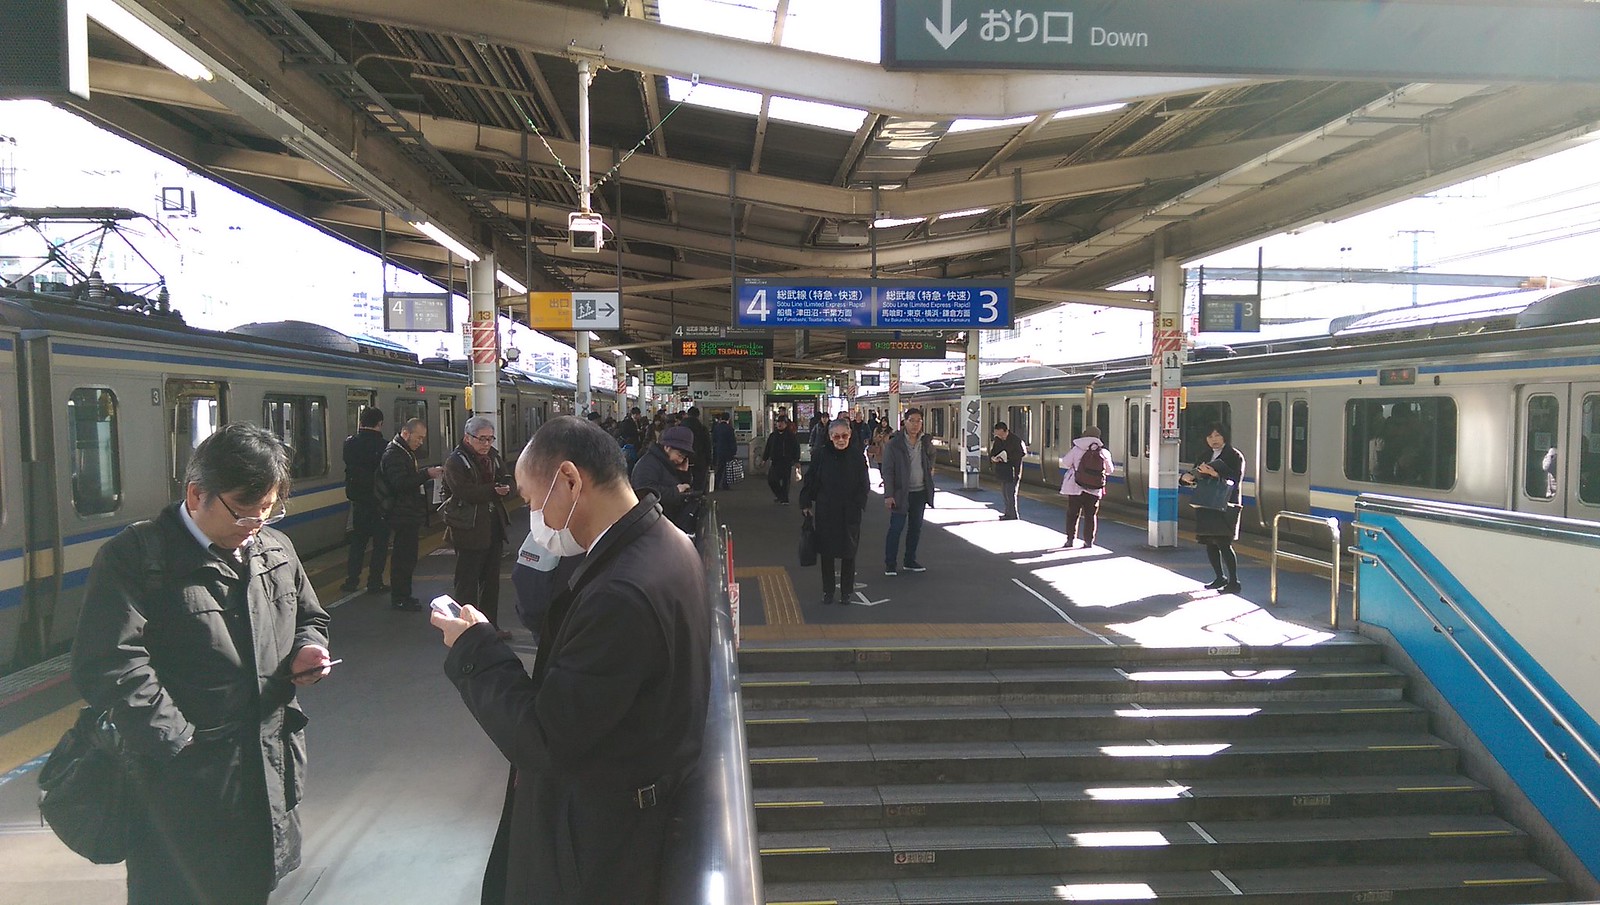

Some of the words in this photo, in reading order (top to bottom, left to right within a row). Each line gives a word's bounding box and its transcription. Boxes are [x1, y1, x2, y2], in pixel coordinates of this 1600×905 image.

[980, 9, 1073, 44] おり口
[1091, 27, 1148, 47] Down
[392, 300, 403, 315] 4
[550, 299, 568, 308] 出口
[746, 289, 770, 322] 4
[978, 290, 998, 323] 3
[1244, 302, 1253, 317] 3
[478, 310, 491, 320] 13
[1162, 318, 1173, 328] 13
[675, 325, 683, 337] 4
[153, 390, 159, 404] 3
